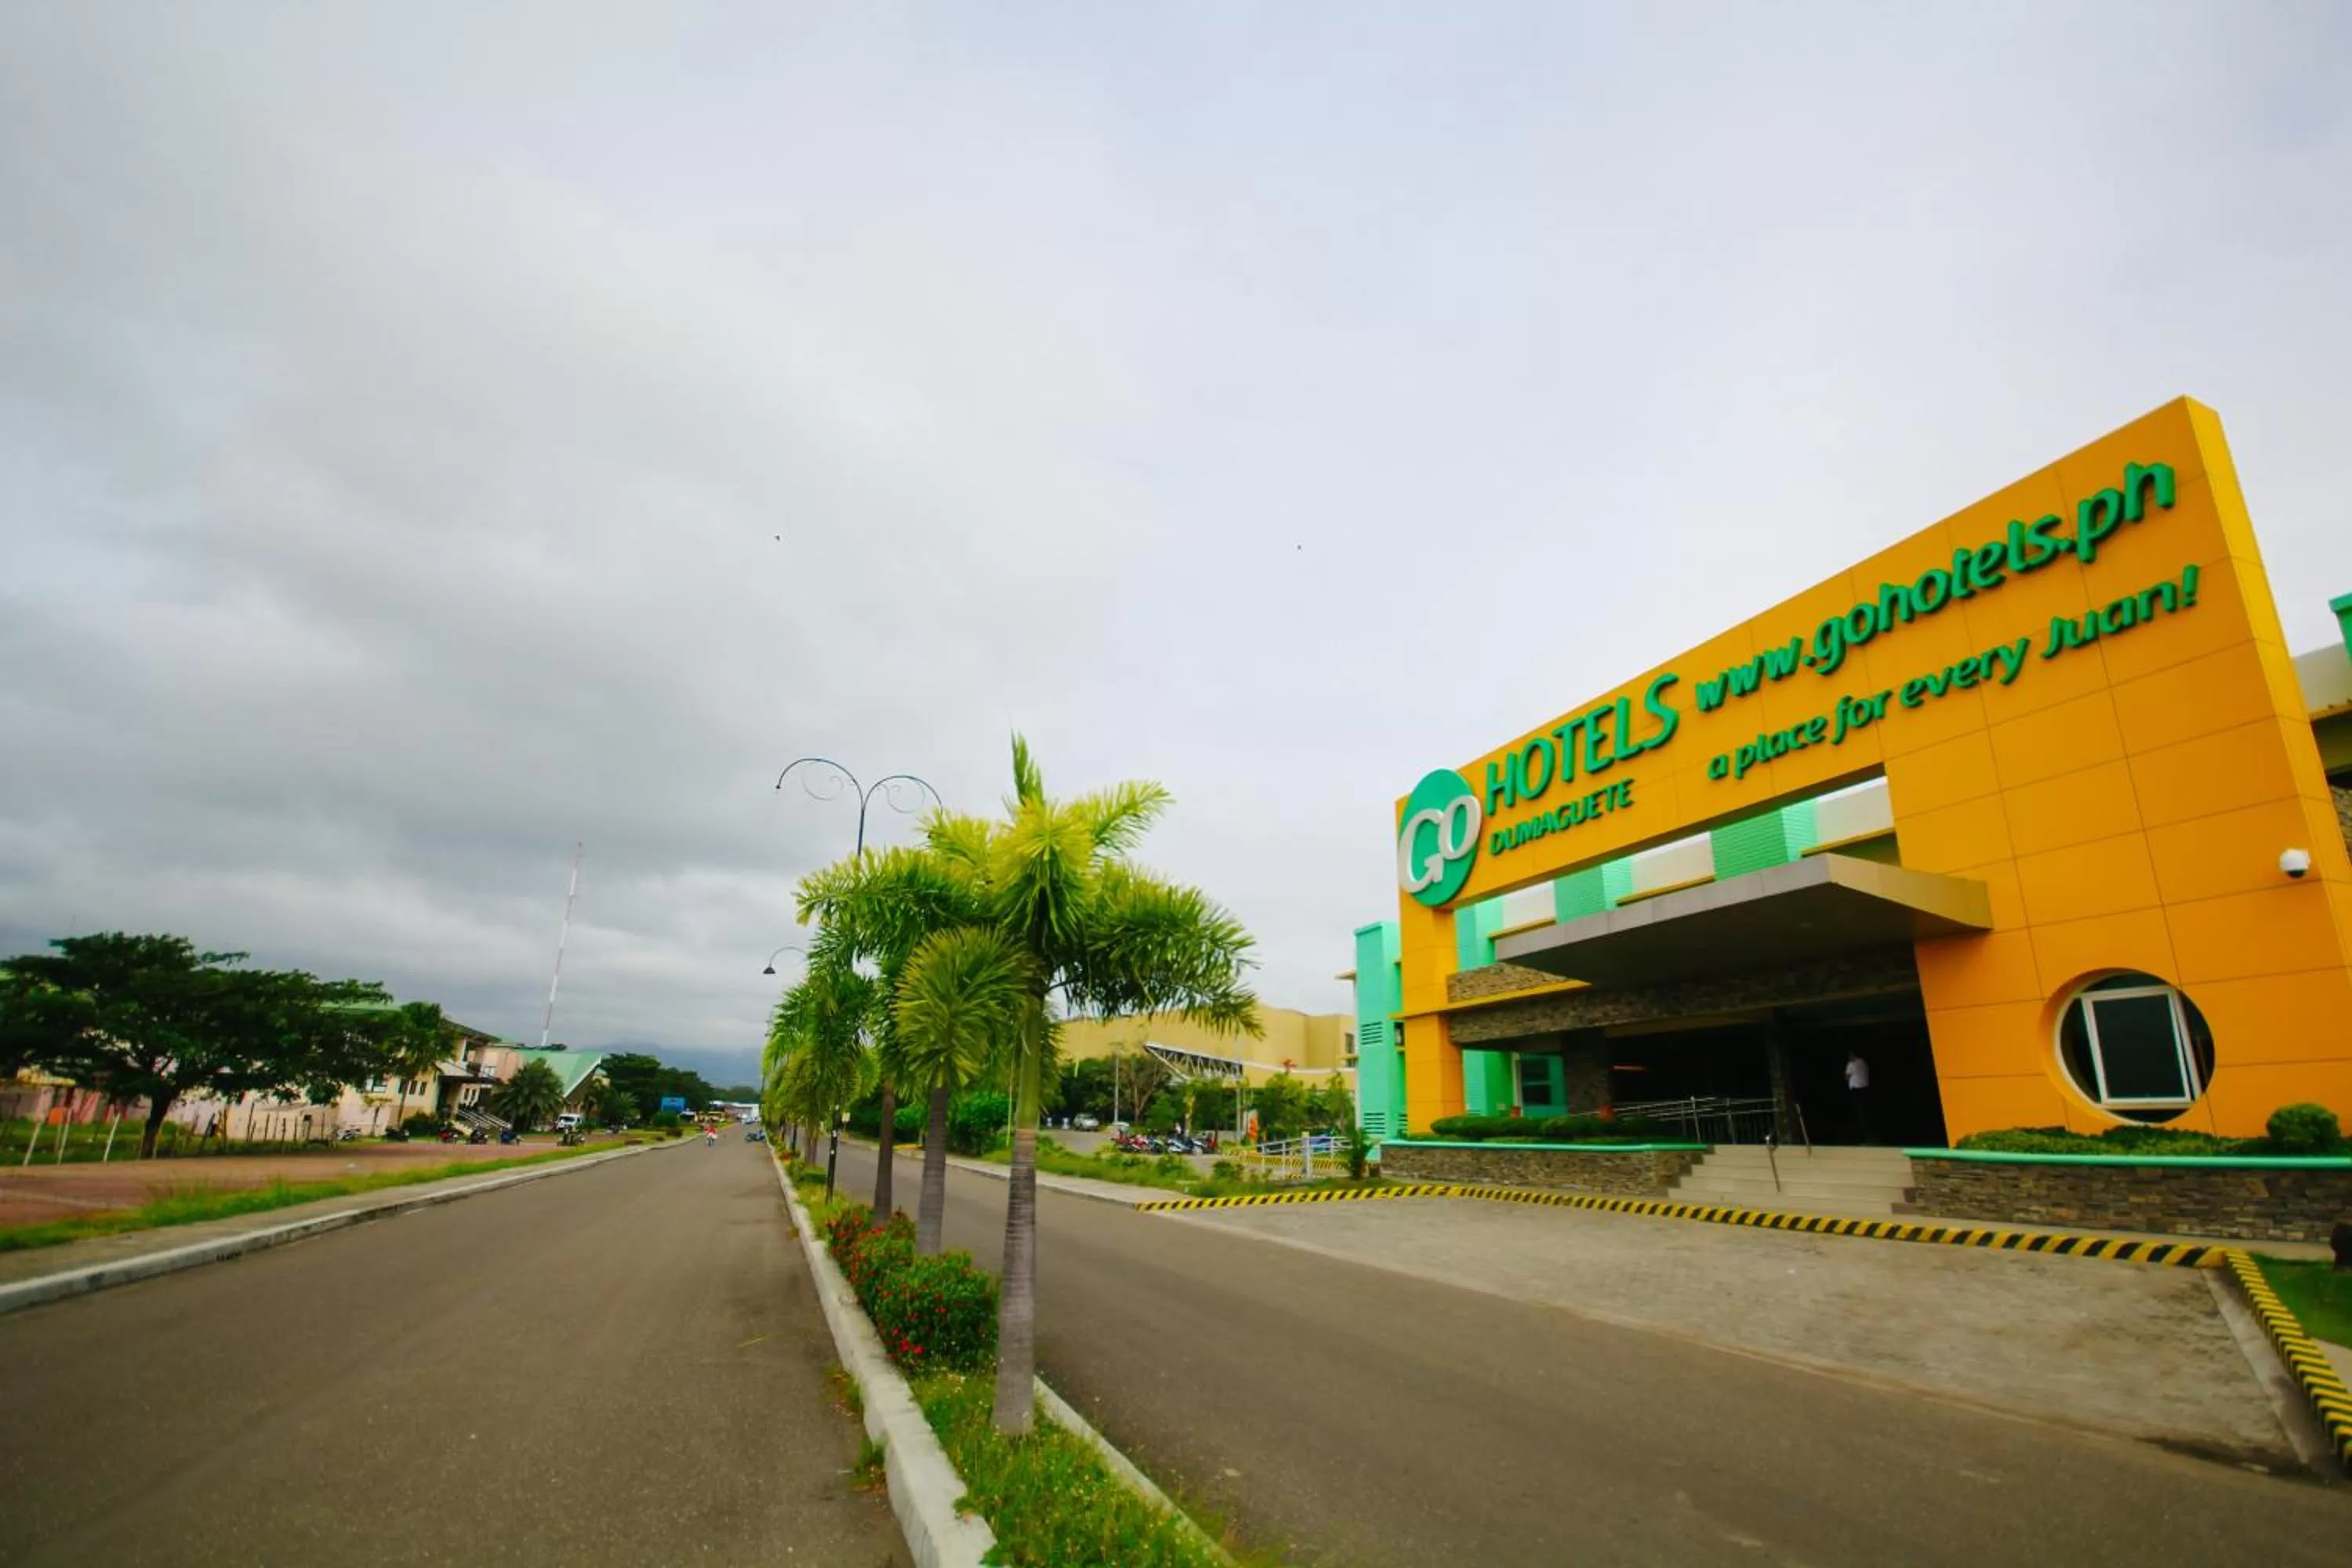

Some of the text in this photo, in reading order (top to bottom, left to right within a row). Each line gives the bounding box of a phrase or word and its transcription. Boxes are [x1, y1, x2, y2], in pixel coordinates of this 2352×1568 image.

[1695, 461, 2176, 713] www.gohotels.ph
[1708, 564, 2200, 780] a place for every Juan!
[1485, 672, 1681, 816] HOTELS
[1490, 778, 1635, 856] DUMAGUETE
